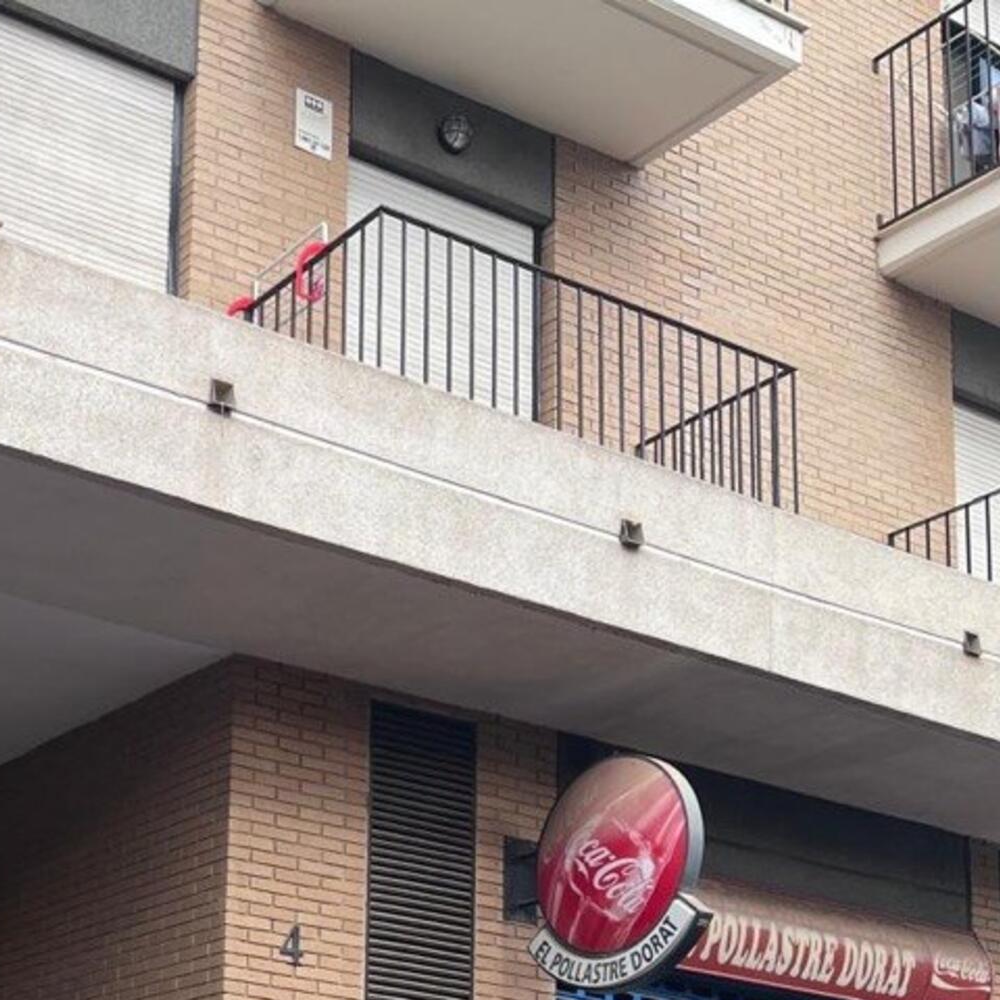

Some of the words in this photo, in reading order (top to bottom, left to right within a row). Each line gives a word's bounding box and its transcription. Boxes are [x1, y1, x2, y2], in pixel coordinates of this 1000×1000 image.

[280, 926, 303, 966] 4
[534, 940, 552, 966] EL
[550, 952, 629, 984] POLLASTRE
[630, 914, 679, 972] DORAT
[700, 911, 838, 984] POLLASTRE
[836, 937, 916, 997] DORAT
